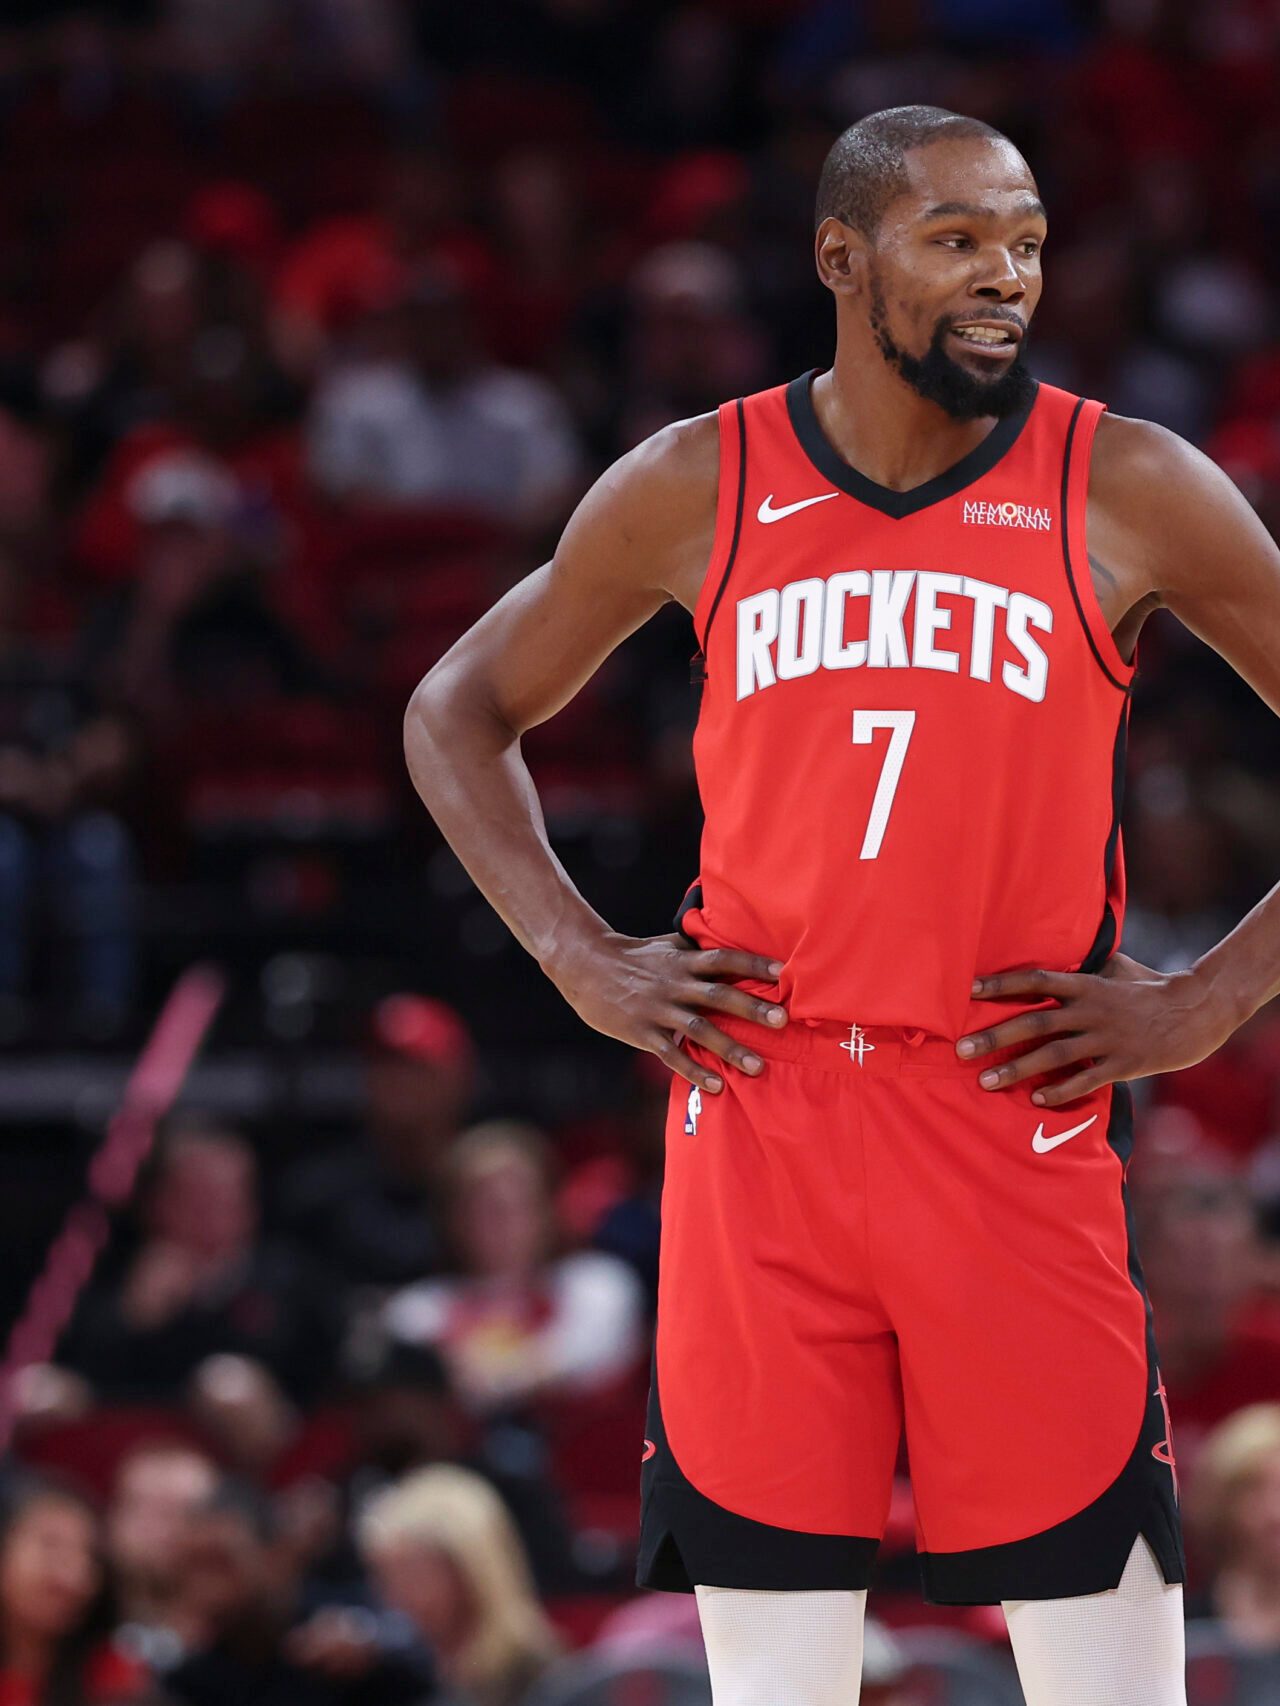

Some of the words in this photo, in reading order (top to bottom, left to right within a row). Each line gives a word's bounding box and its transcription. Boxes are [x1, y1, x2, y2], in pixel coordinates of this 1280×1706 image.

[963, 500, 1052, 521] MEMORIAL
[963, 512, 1051, 531] HERMANN
[736, 570, 1053, 703] ROCKETS
[852, 710, 916, 860] 7
